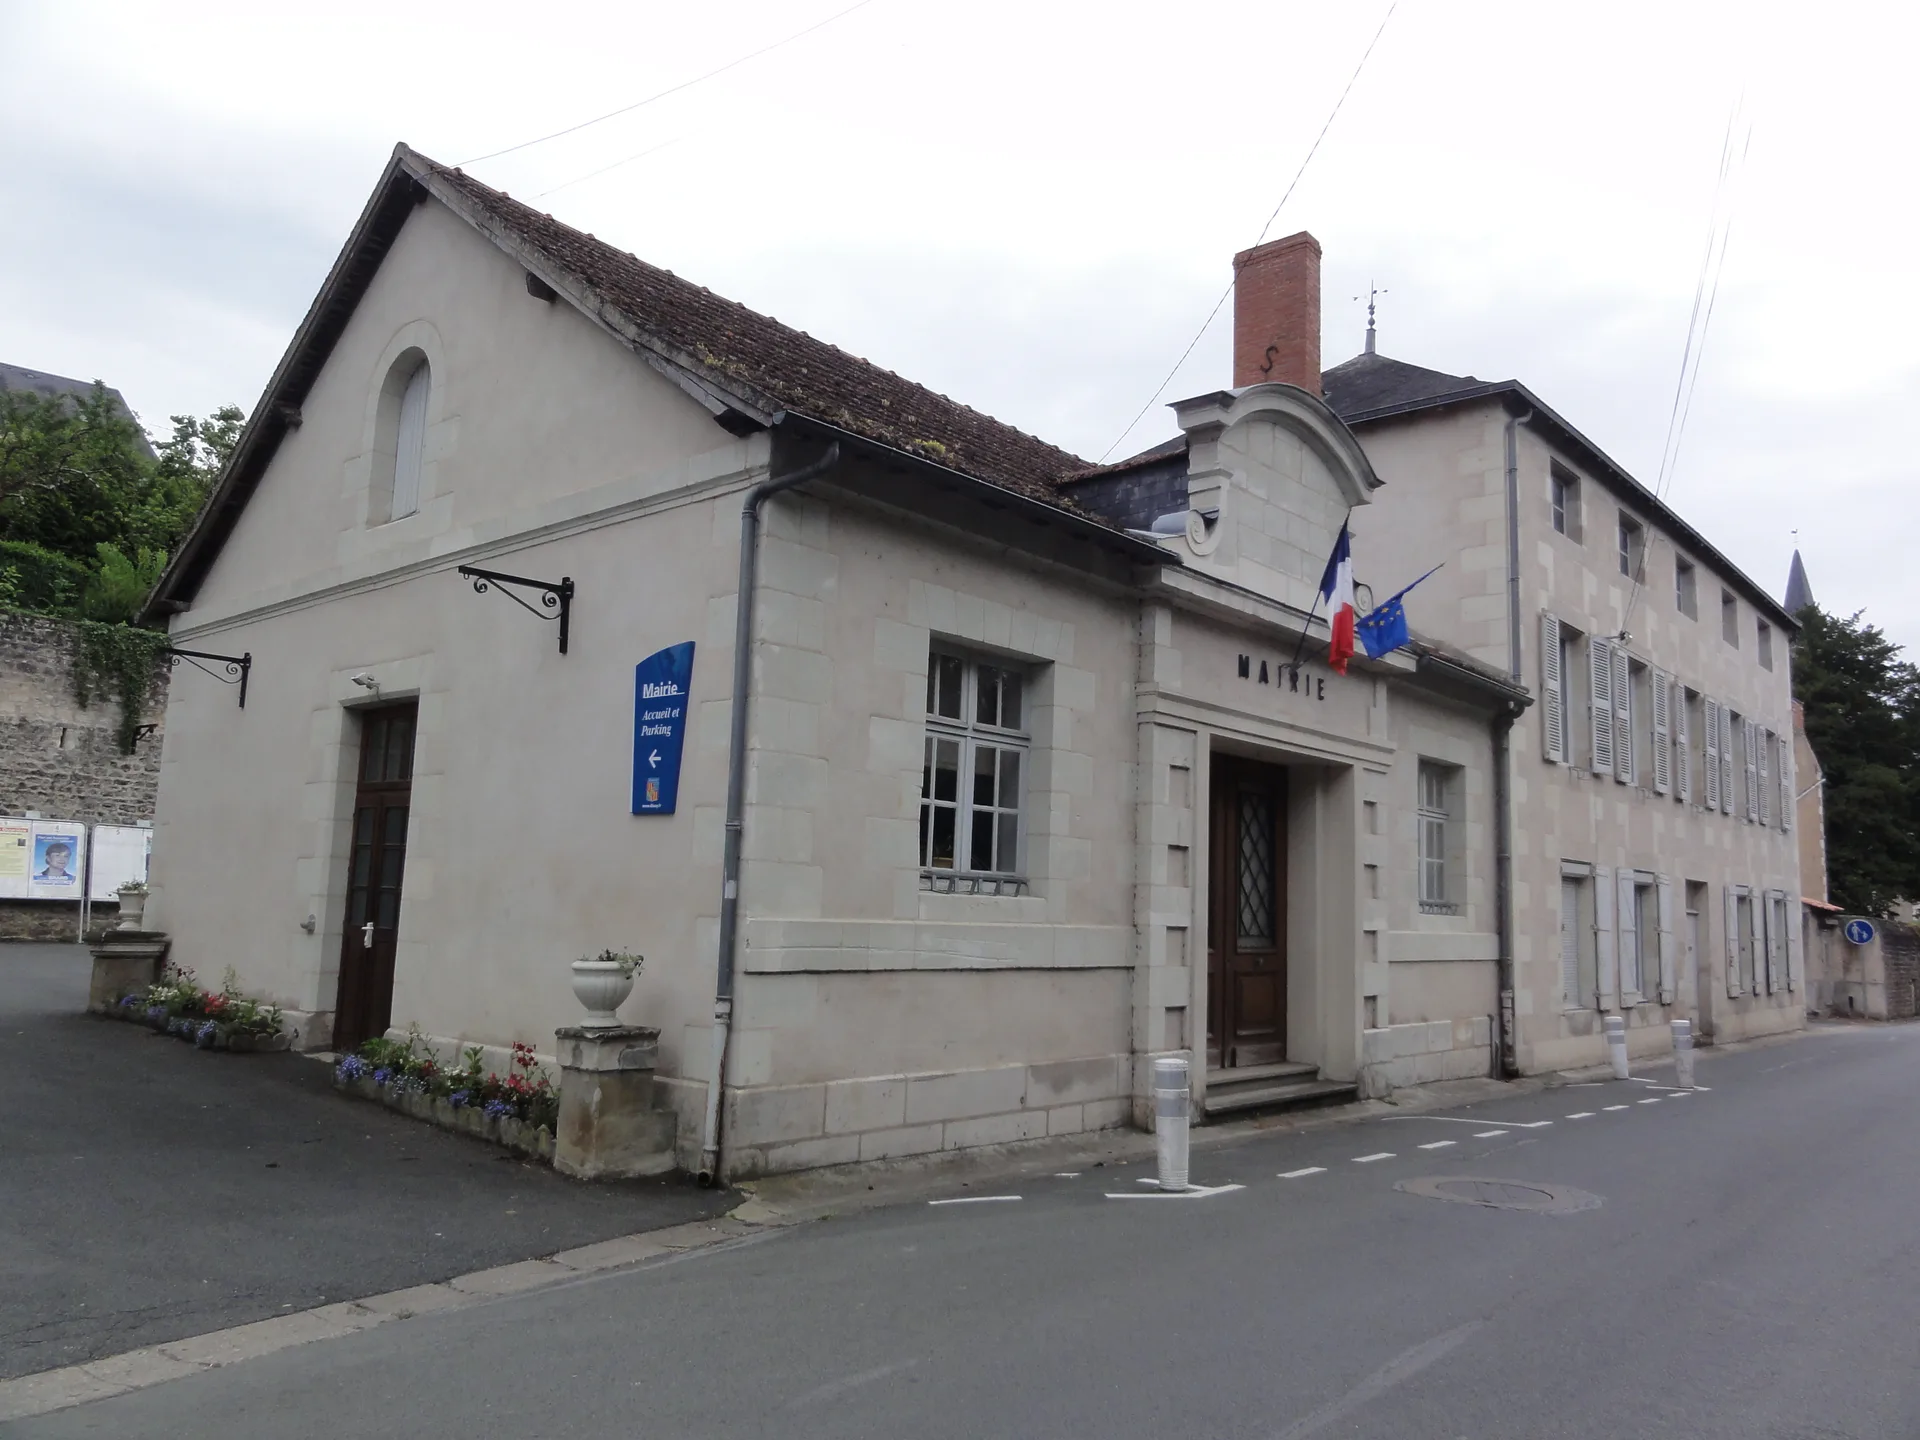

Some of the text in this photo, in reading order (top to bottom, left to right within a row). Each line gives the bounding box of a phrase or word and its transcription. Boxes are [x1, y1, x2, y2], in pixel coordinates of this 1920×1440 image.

[1238, 653, 1325, 701] MAIRIE
[643, 681, 678, 698] Mairie
[642, 708, 680, 721] Accueil et
[641, 724, 672, 737] Parking
